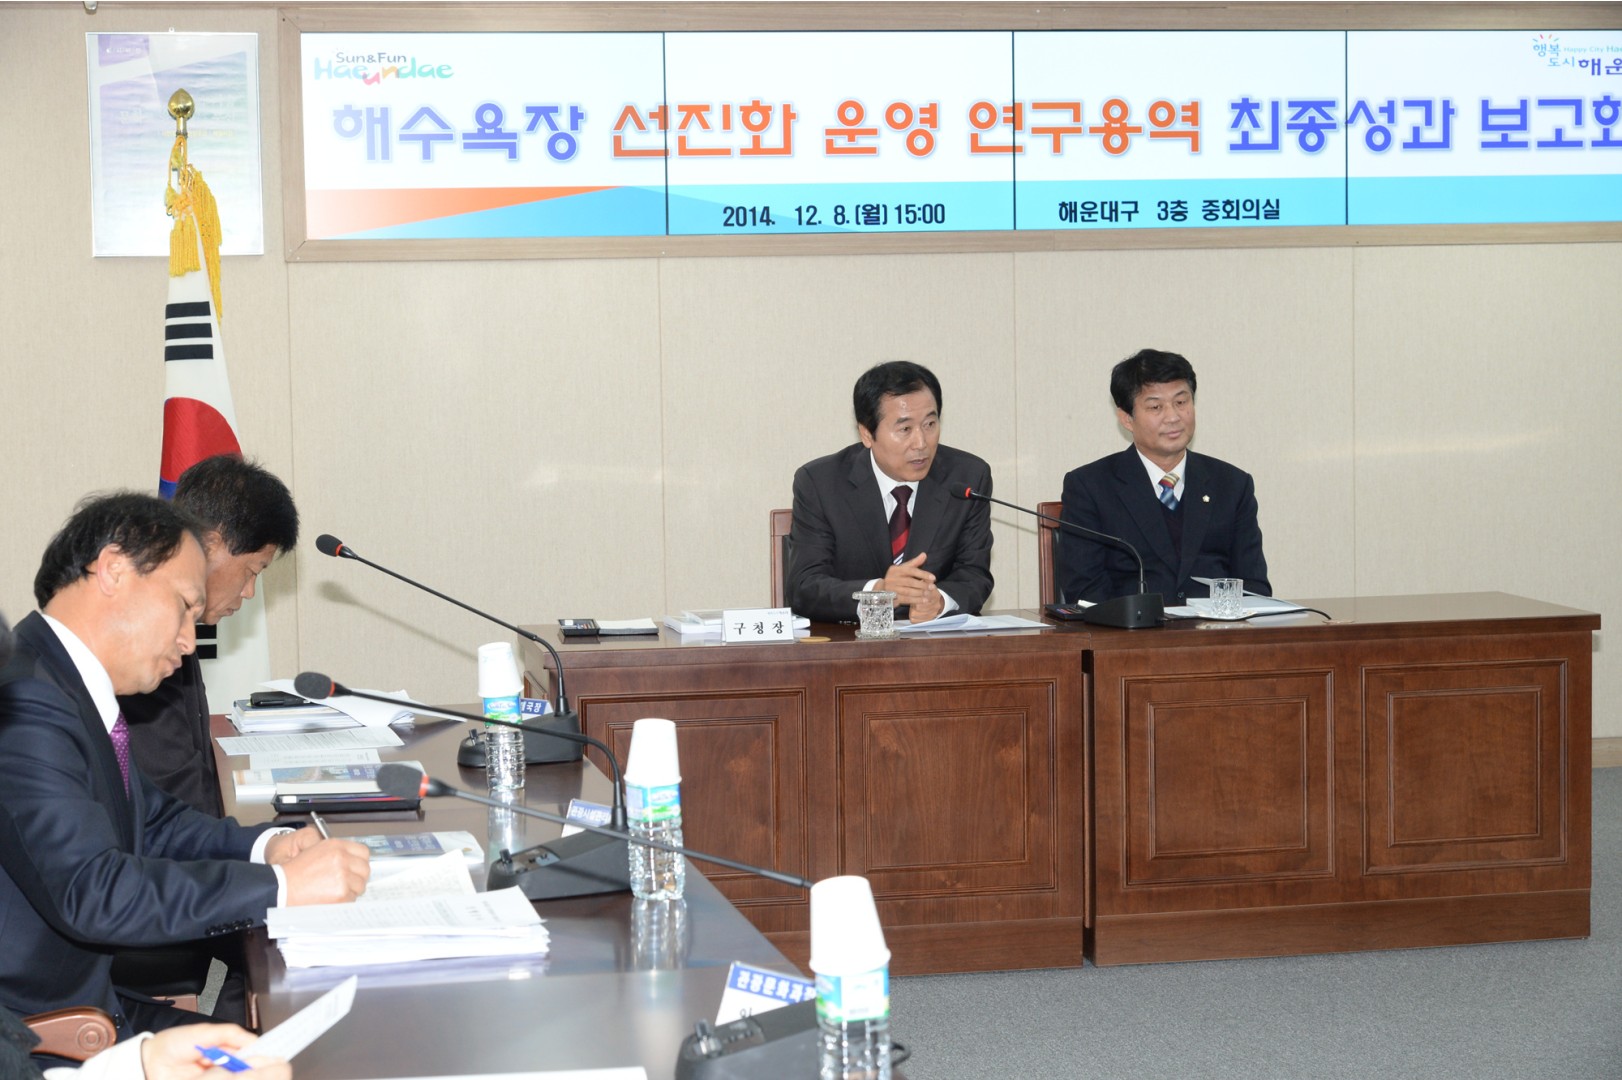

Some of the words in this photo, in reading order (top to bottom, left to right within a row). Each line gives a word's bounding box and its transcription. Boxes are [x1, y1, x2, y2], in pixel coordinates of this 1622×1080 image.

[335, 51, 407, 63] Sun&Fun
[1533, 43, 1561, 57] 행복
[1547, 56, 1575, 67] 도시
[314, 57, 455, 85] Haeundae
[333, 102, 585, 161] 해수욕장
[613, 99, 797, 158] 선진화
[825, 99, 938, 157] 운영
[969, 98, 1200, 156] 연구용역
[1229, 96, 1456, 153] 최종성과
[722, 206, 776, 227] 2014.
[794, 205, 822, 226] 12.
[894, 203, 945, 224] 15:00
[1058, 200, 1140, 222] 해운대구
[1157, 199, 1189, 222] 3층
[1201, 198, 1280, 222] 중회의실
[733, 620, 785, 636] 구청장
